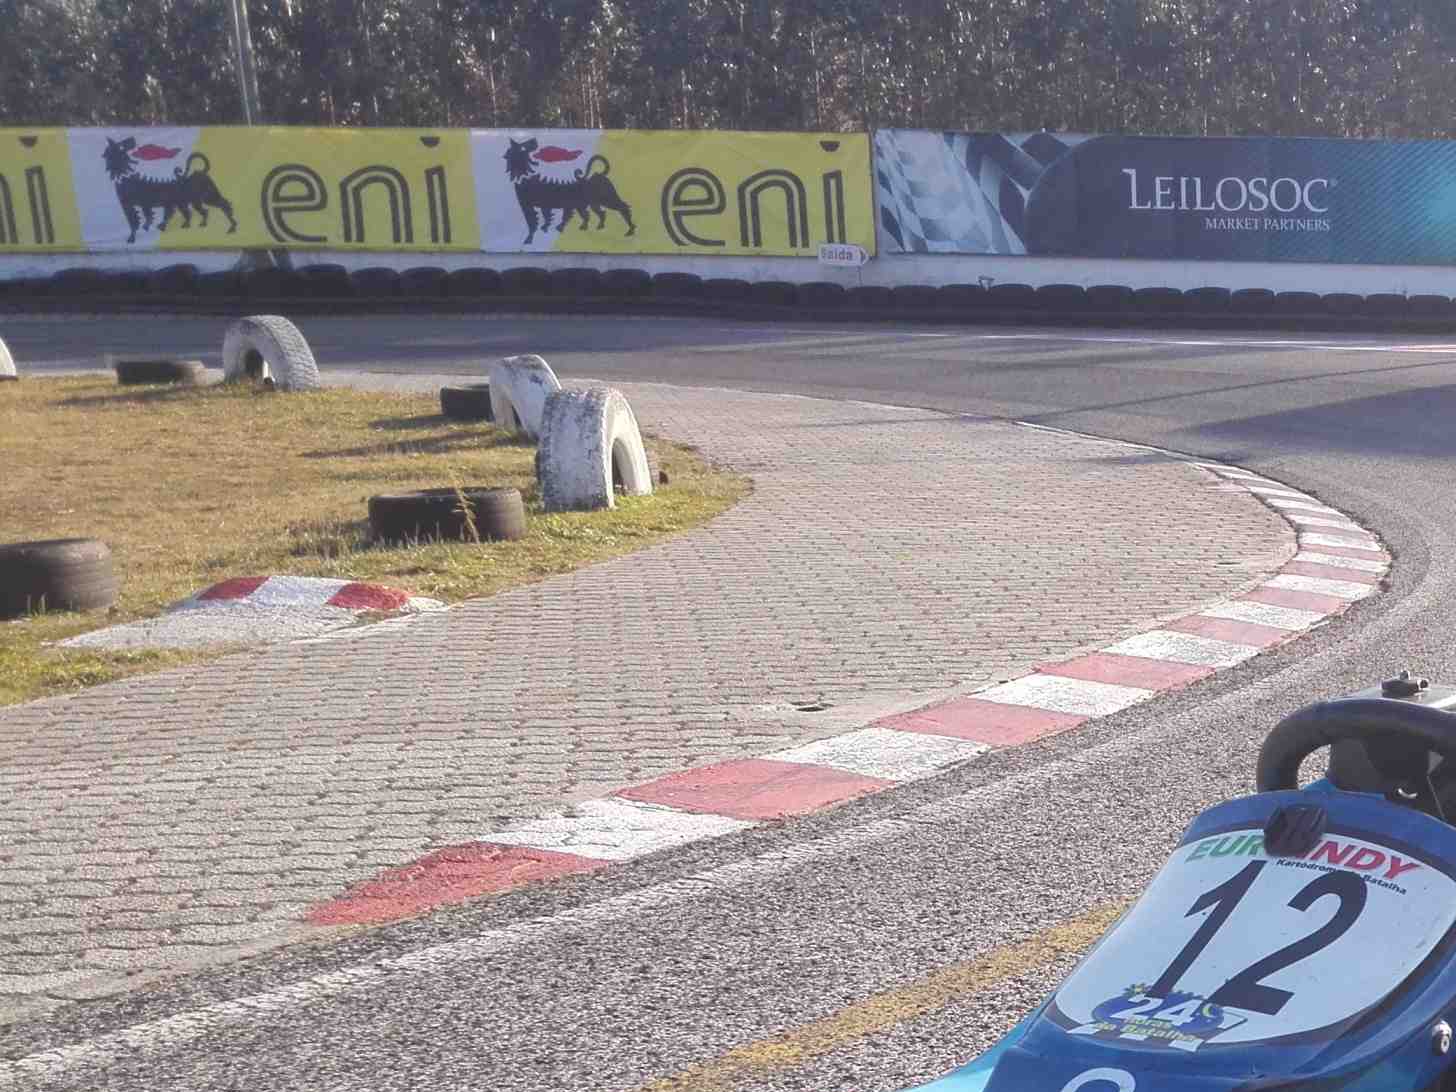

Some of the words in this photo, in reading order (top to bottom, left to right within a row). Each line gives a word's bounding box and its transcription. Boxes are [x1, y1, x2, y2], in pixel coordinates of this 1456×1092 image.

[260, 135, 452, 244] eni
[661, 139, 847, 248] eni
[1121, 168, 1329, 213] LEILOSOC
[1205, 217, 1259, 231] MARKET
[1263, 218, 1331, 232] PARTNERS
[1148, 859, 1368, 1016] 12
